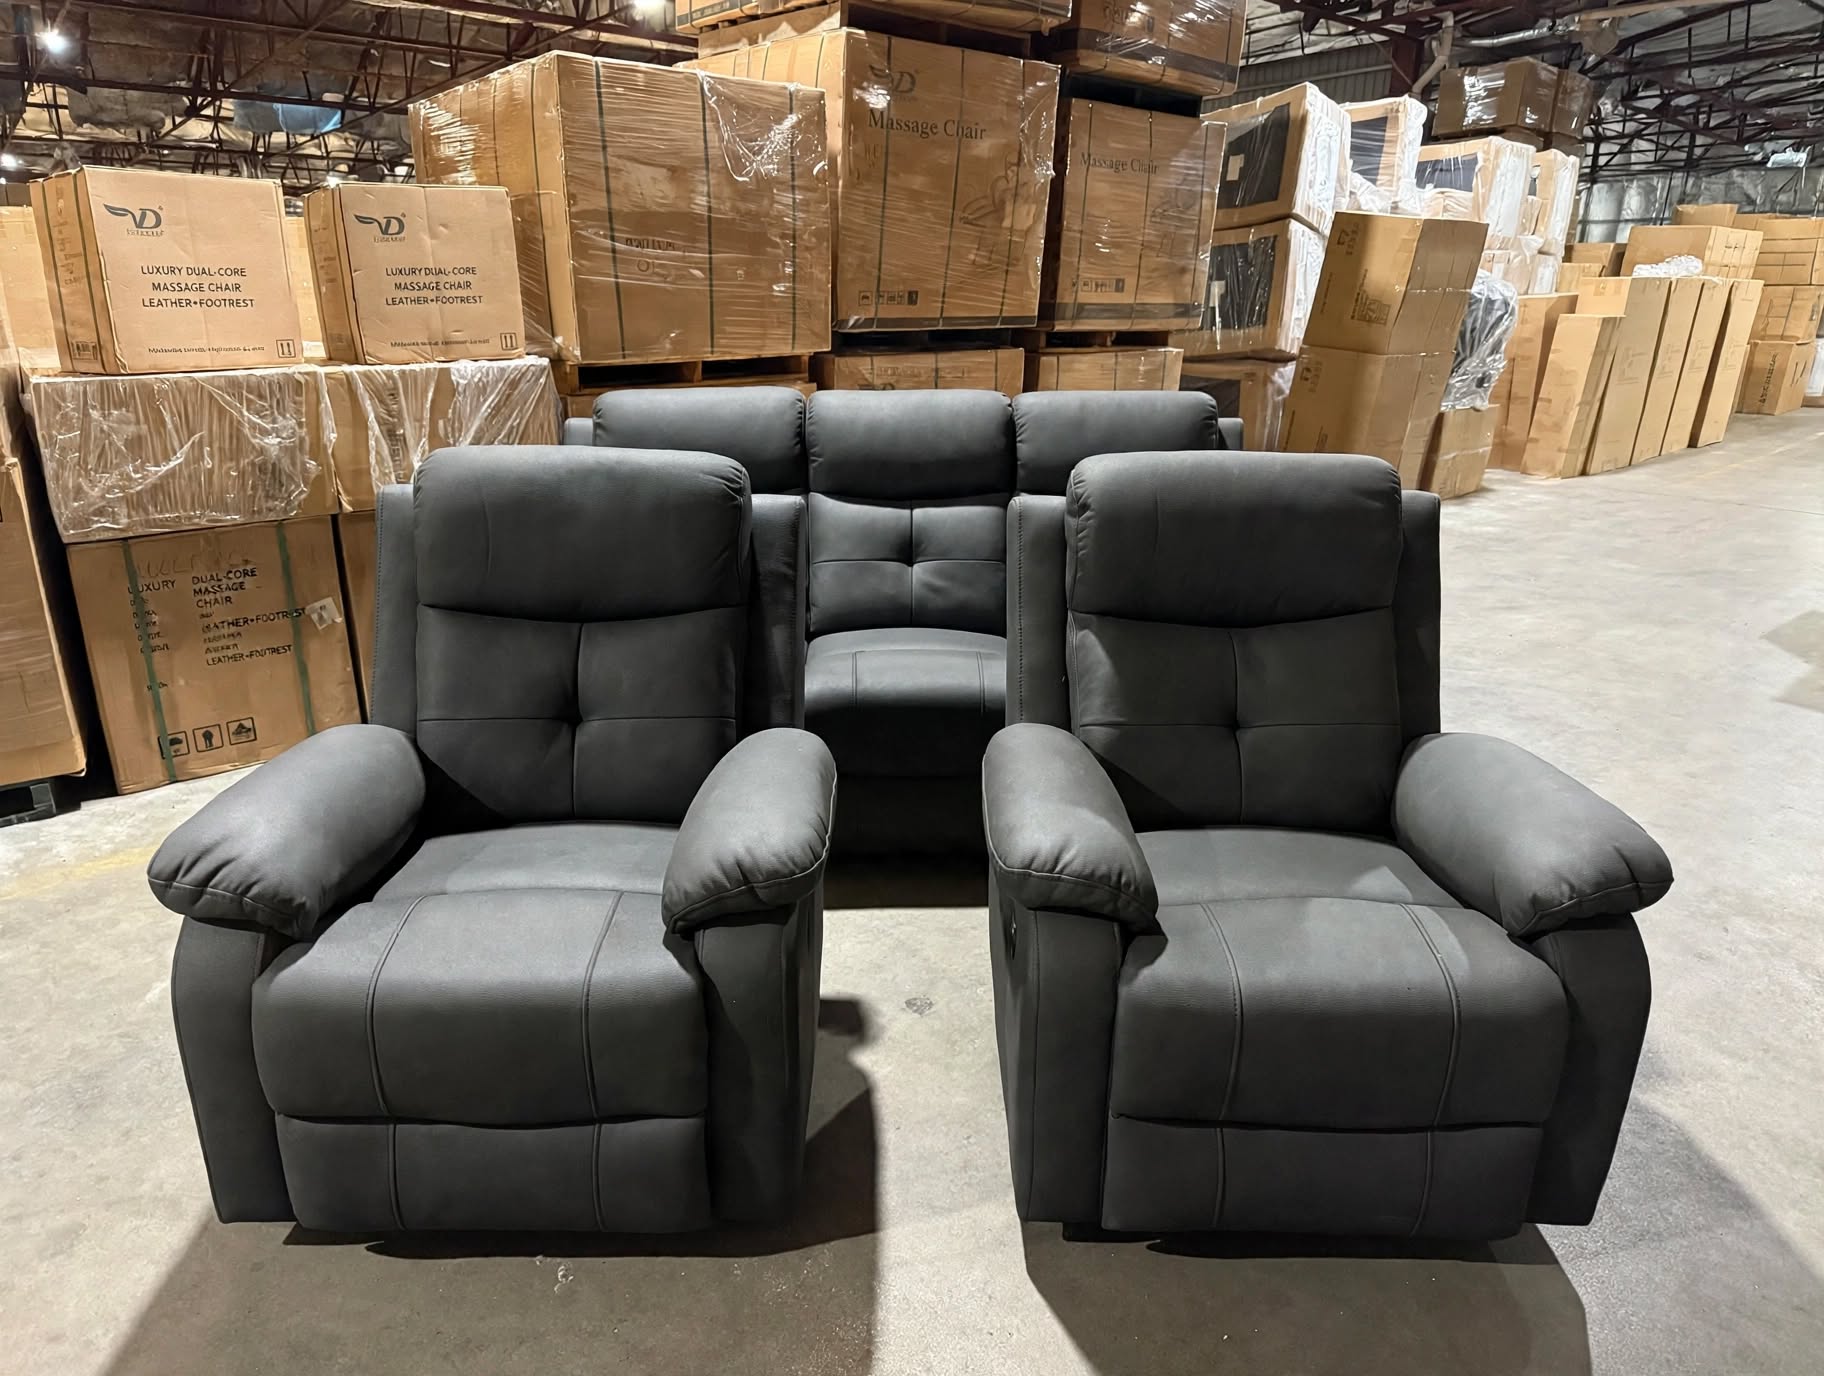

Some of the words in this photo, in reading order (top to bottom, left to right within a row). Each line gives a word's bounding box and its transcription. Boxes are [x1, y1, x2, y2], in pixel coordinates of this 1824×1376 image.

[868, 109, 938, 139] Massage
[943, 119, 987, 140] Chair
[1080, 152, 1128, 173] Massage
[1130, 159, 1159, 175] Chair
[140, 265, 183, 276] LUXURY
[385, 267, 423, 276] LUXURY
[151, 282, 205, 293] MASSAGE
[208, 282, 242, 293] CHAIR
[394, 281, 442, 291] MASSAGE
[443, 280, 472, 290] CHAIR
[196, 596, 233, 609] CHAIR
